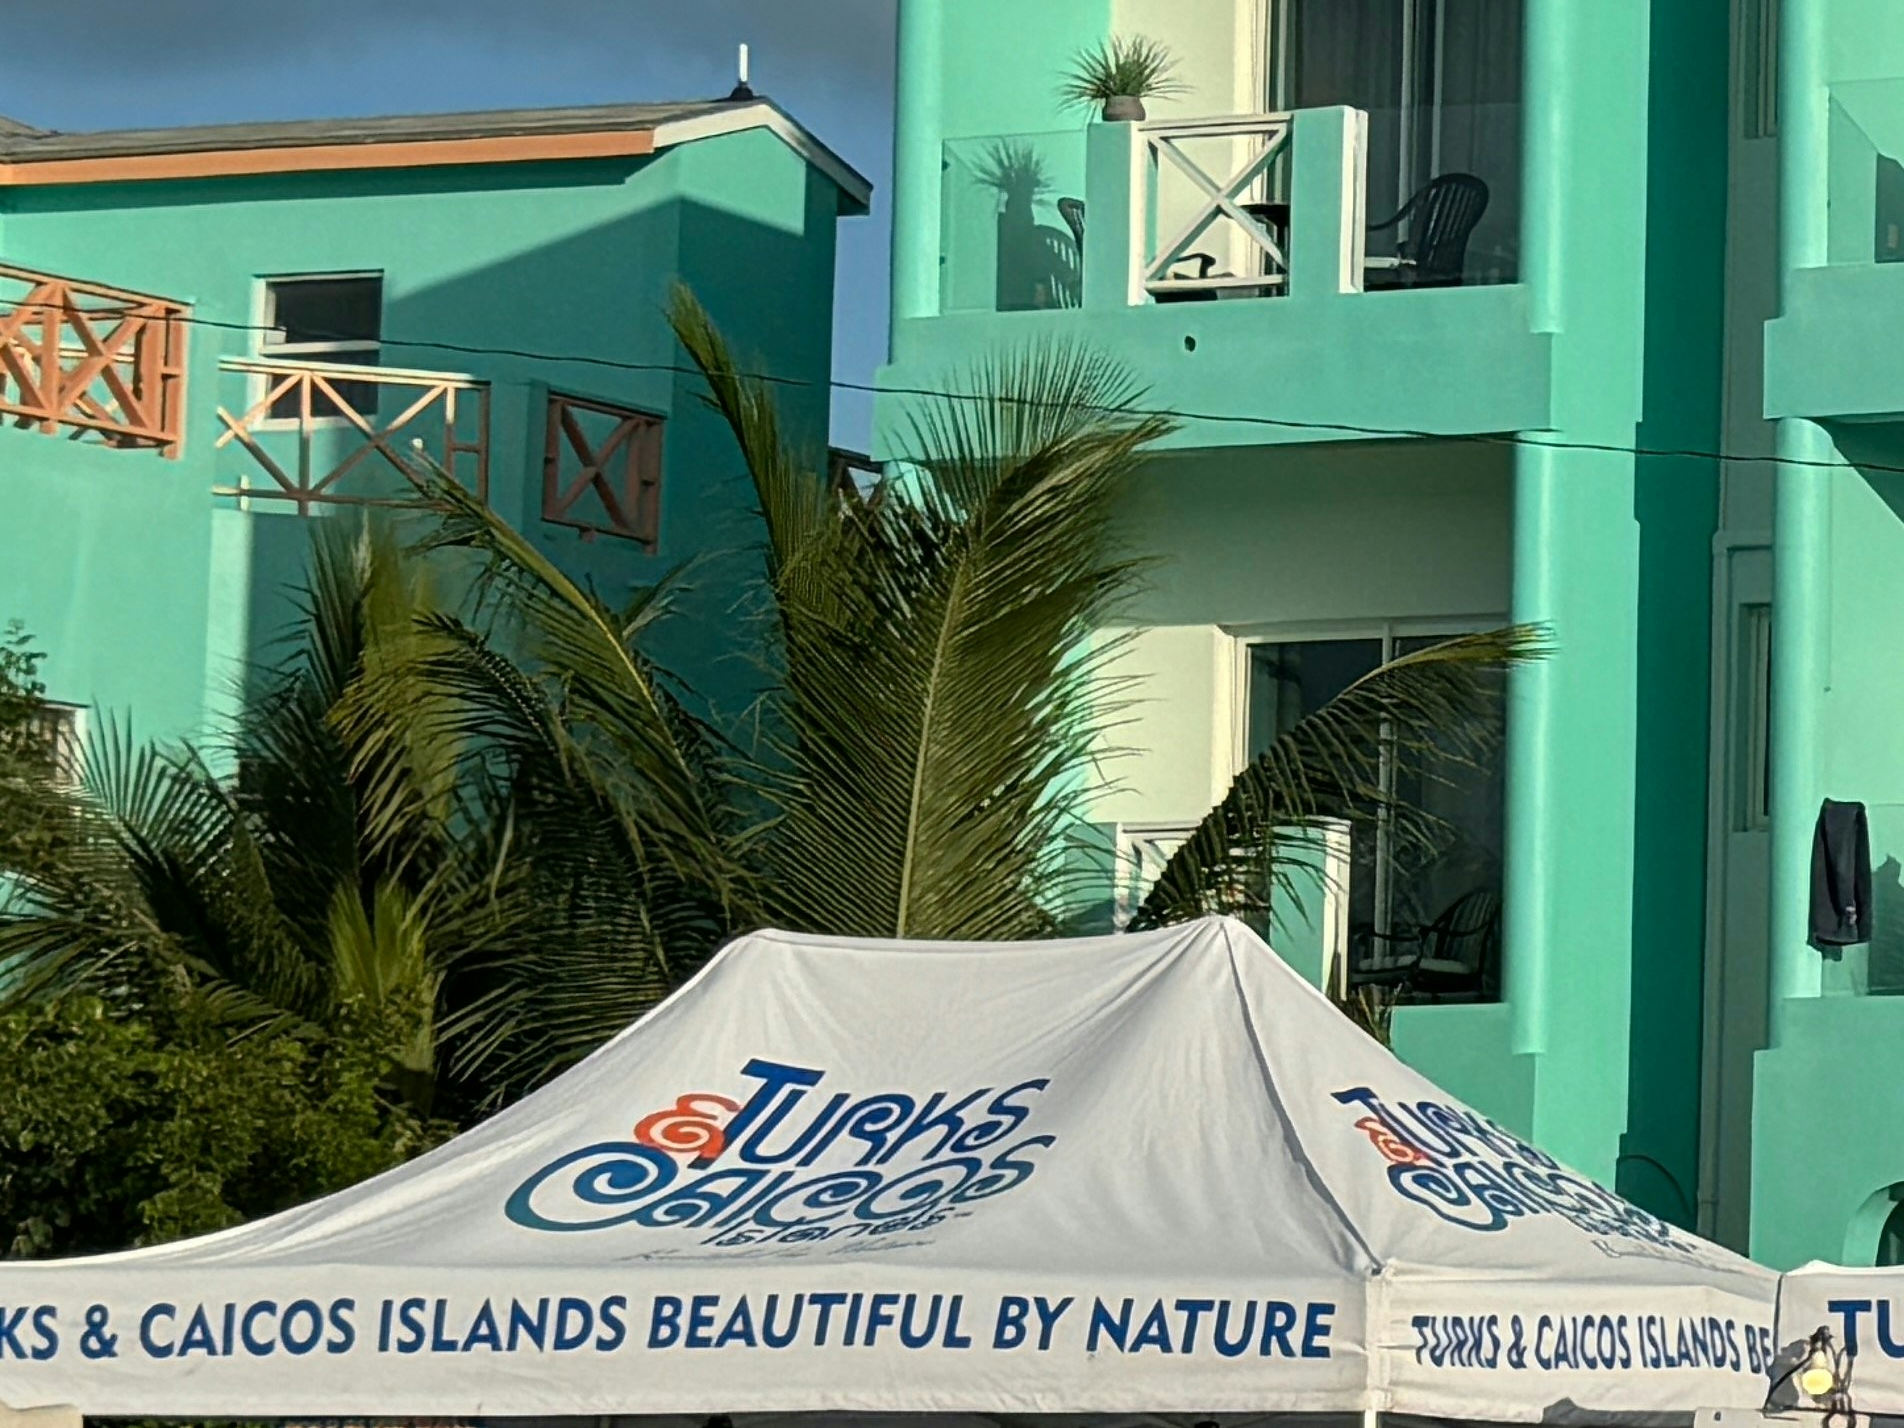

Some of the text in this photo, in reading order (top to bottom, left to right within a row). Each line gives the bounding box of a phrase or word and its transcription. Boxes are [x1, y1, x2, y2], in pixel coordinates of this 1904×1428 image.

[80, 1304, 118, 1358] &
[140, 1298, 356, 1358] CAICOS
[379, 1295, 626, 1353] ISLANDS
[647, 1291, 972, 1349] BEAUTIFUL
[993, 1295, 1076, 1351] BY
[1086, 1297, 1335, 1359] NATURE
[1412, 1315, 1500, 1369] TURKS
[1507, 1315, 1527, 1369] &
[1534, 1314, 1630, 1370] CAICOS
[1638, 1315, 1741, 1372] ISLANDS
